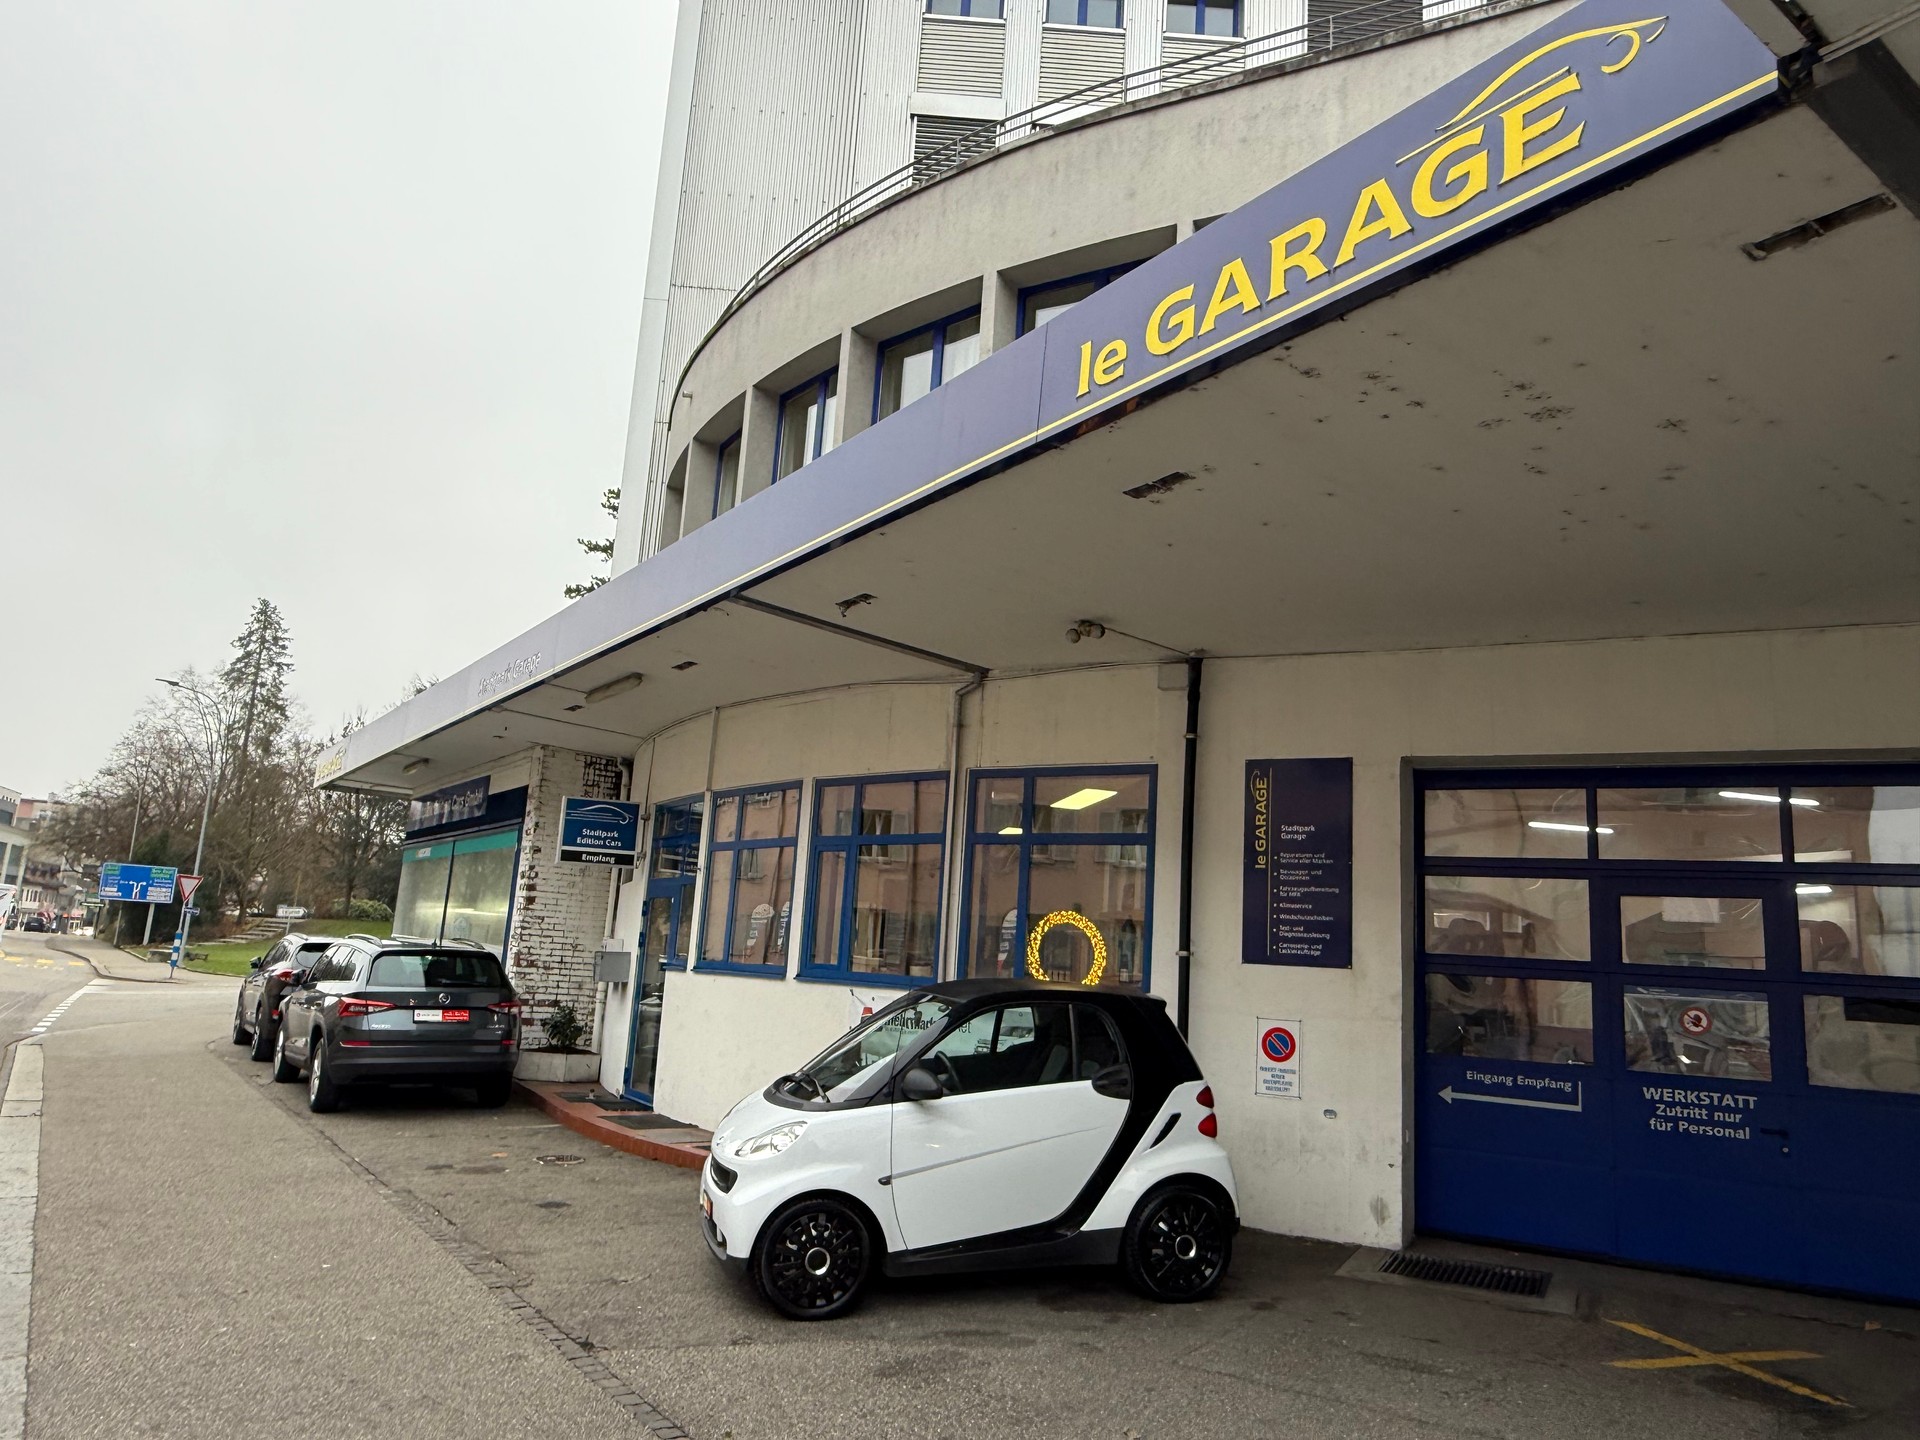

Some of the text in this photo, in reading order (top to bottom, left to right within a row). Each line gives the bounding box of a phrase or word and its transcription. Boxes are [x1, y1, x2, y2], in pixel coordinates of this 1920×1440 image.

[1075, 72, 1584, 399] le GARAGE
[582, 828, 619, 838] Stadtpark
[1255, 777, 1267, 869] le GARAGE
[576, 837, 622, 847] Edition Cars
[581, 853, 616, 864] Empfang
[1466, 1071, 1572, 1092] Eingang Empfang
[1642, 1086, 1758, 1109] WERKSTATT
[1655, 1103, 1743, 1123] Zutritt nur
[1649, 1117, 1750, 1140] für Personal
